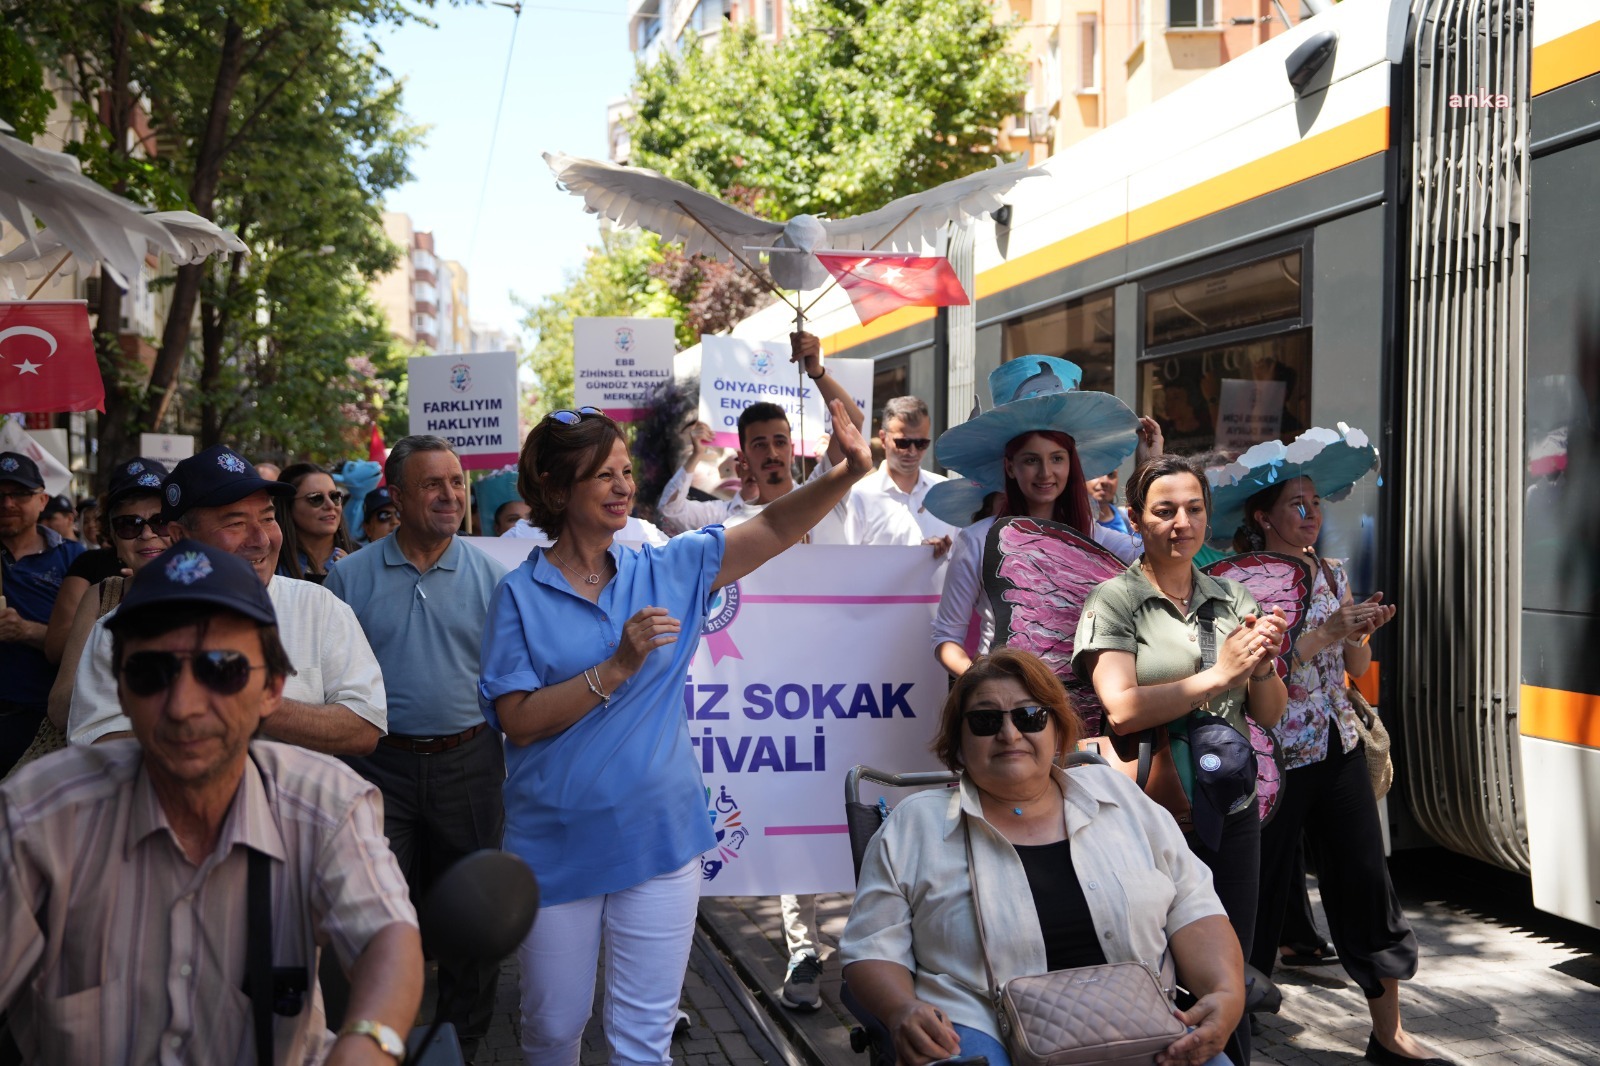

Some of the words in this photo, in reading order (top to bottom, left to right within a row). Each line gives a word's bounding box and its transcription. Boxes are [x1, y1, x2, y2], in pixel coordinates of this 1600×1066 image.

[615, 358, 635, 366] EBB
[580, 369, 626, 378] ZİHİNSEL
[629, 368, 670, 377] ENGELLİ
[586, 380, 628, 389] GÜNDÜZ
[713, 377, 811, 399] ÖNYARGINIZ
[423, 398, 503, 413] FARKLIYIM
[427, 416, 500, 431] HAKLIYIM
[446, 434, 502, 447] RDAYIM
[742, 682, 916, 720] SOKAK
